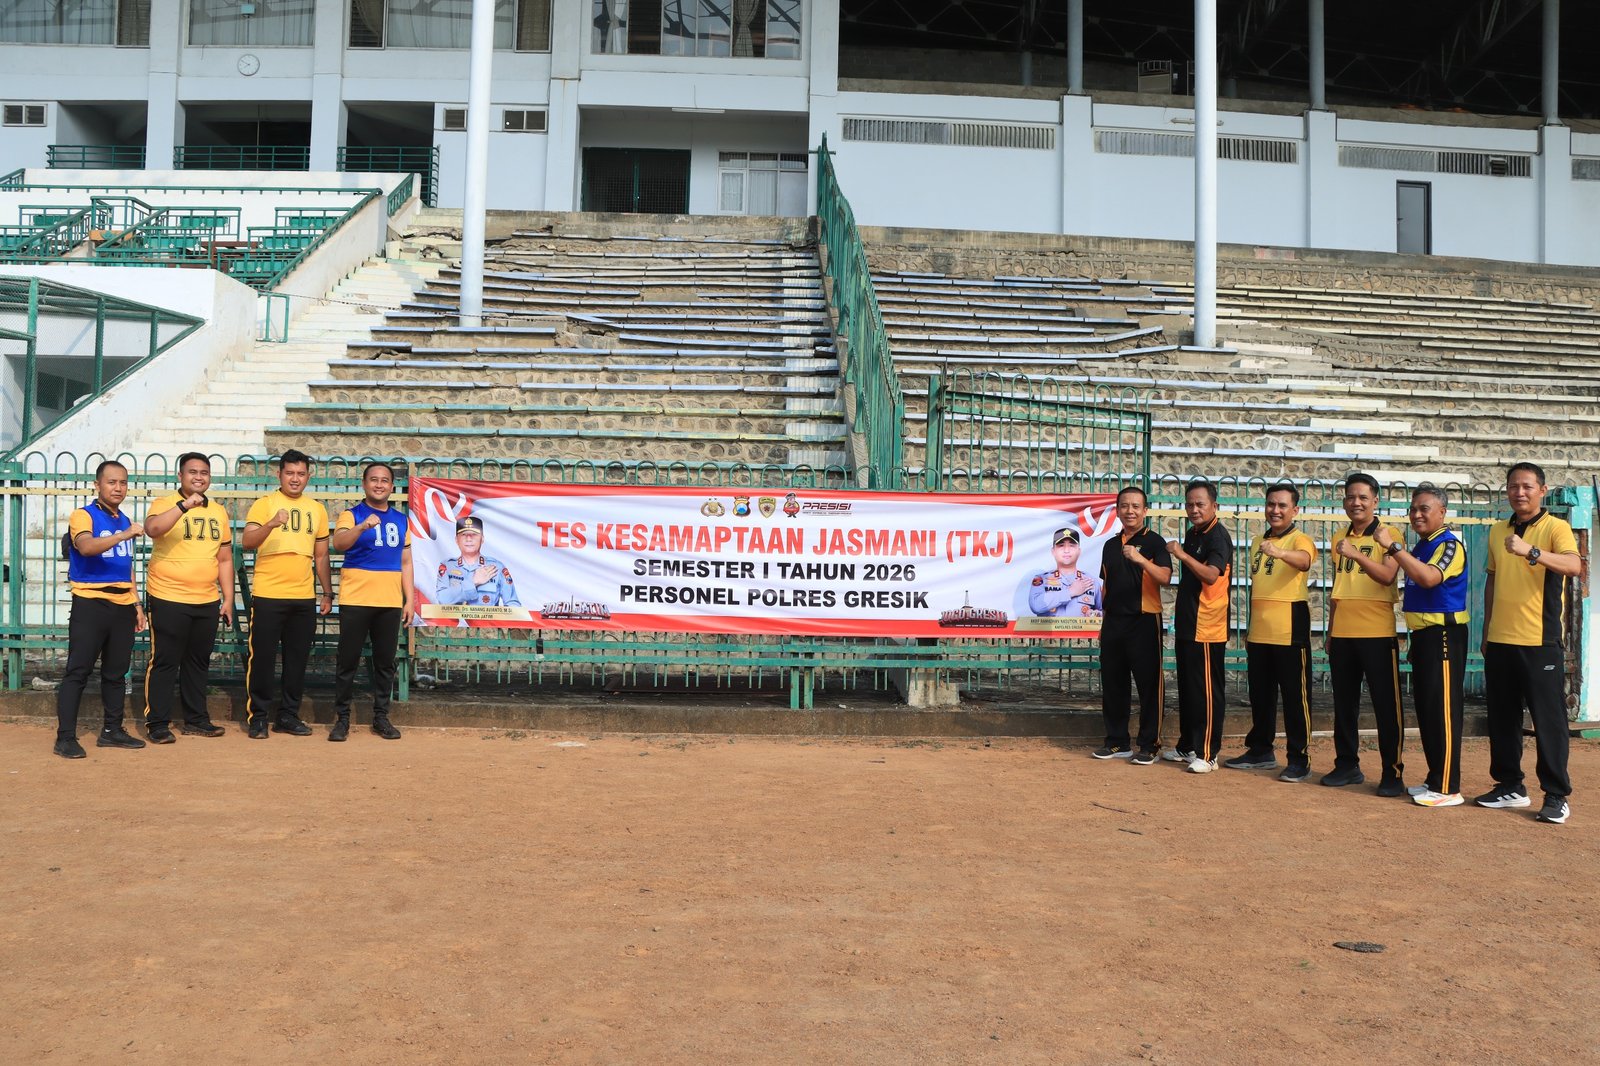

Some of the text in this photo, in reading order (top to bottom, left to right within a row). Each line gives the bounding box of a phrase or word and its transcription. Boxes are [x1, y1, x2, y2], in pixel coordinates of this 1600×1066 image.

[802, 502, 852, 511] PRESISI
[183, 517, 220, 541] 176
[374, 522, 400, 548] 18
[536, 522, 1014, 563] TES KESAMAPTAAN JASMANI (TKJ)
[633, 558, 916, 582] SEMESTER I TAHUN 2026
[620, 584, 929, 609] PERSONEL POLRES GRESIK
